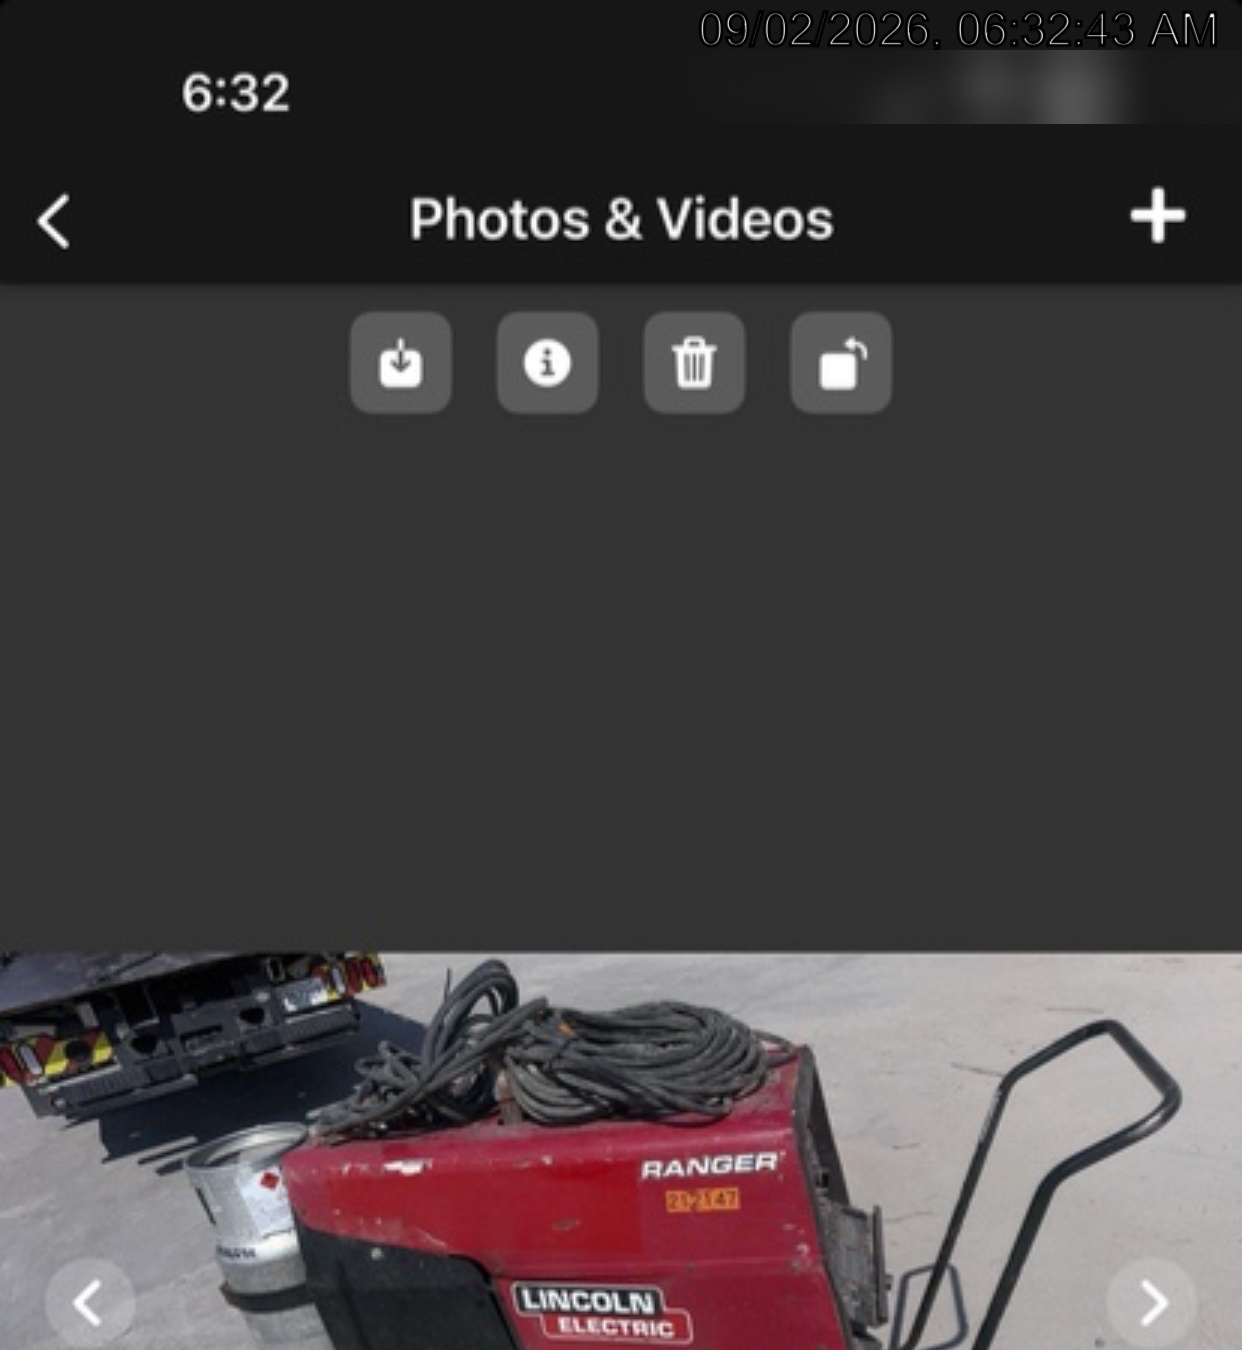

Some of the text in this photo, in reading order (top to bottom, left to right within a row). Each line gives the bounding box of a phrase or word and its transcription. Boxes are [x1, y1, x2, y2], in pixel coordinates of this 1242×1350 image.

[182, 71, 290, 113] 6:32
[411, 194, 834, 241] Photos & Videos
[641, 1152, 778, 1181] RANGER
[521, 1288, 657, 1316] LINCOLN
[558, 1316, 676, 1340] ELECTRIC
